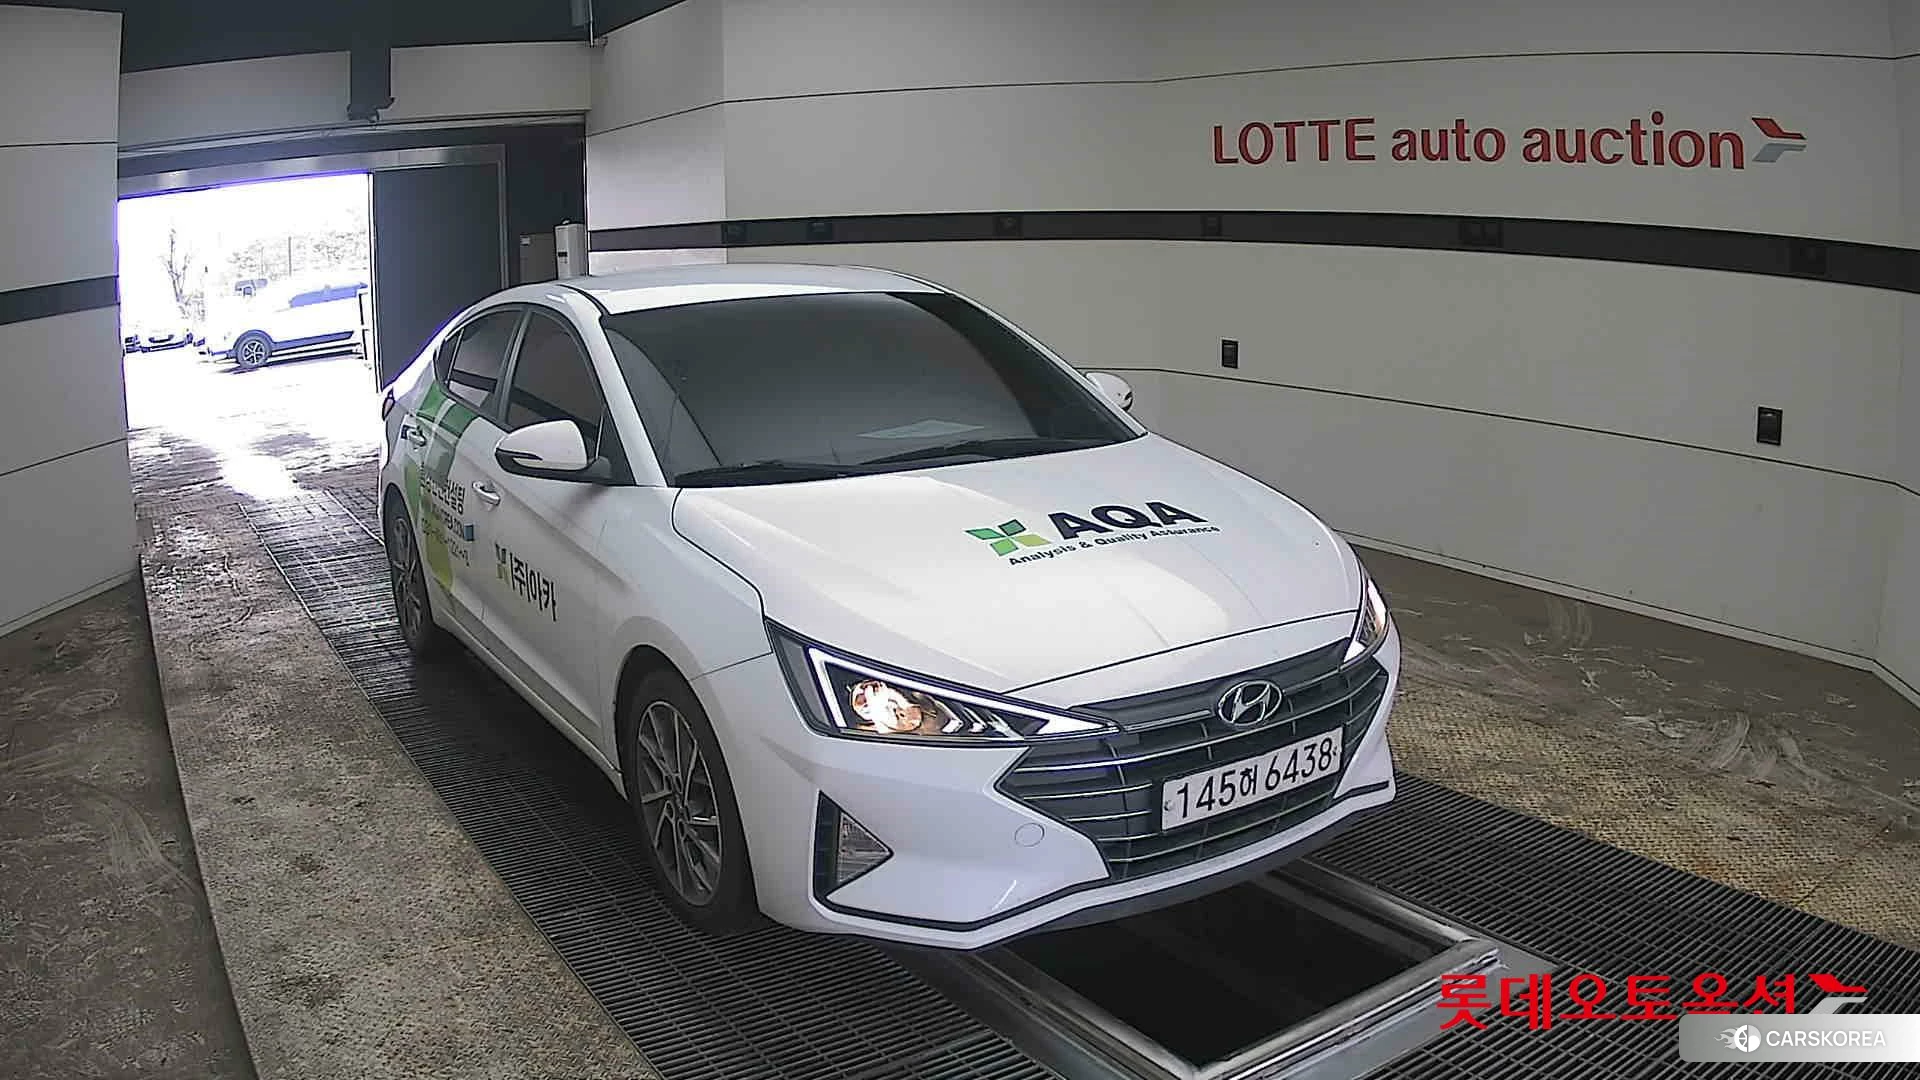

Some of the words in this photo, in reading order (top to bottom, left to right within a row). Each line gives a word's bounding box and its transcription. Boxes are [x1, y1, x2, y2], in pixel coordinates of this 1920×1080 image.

[1212, 118, 1376, 164] LOTTE
[1391, 118, 1506, 163] auto
[1522, 111, 1746, 170] auction
[1048, 501, 1207, 540] AQA
[1008, 542, 1077, 566] Analysis
[1080, 540, 1093, 549] &
[1094, 531, 1148, 547] Quality
[1150, 525, 1220, 537] Assurance
